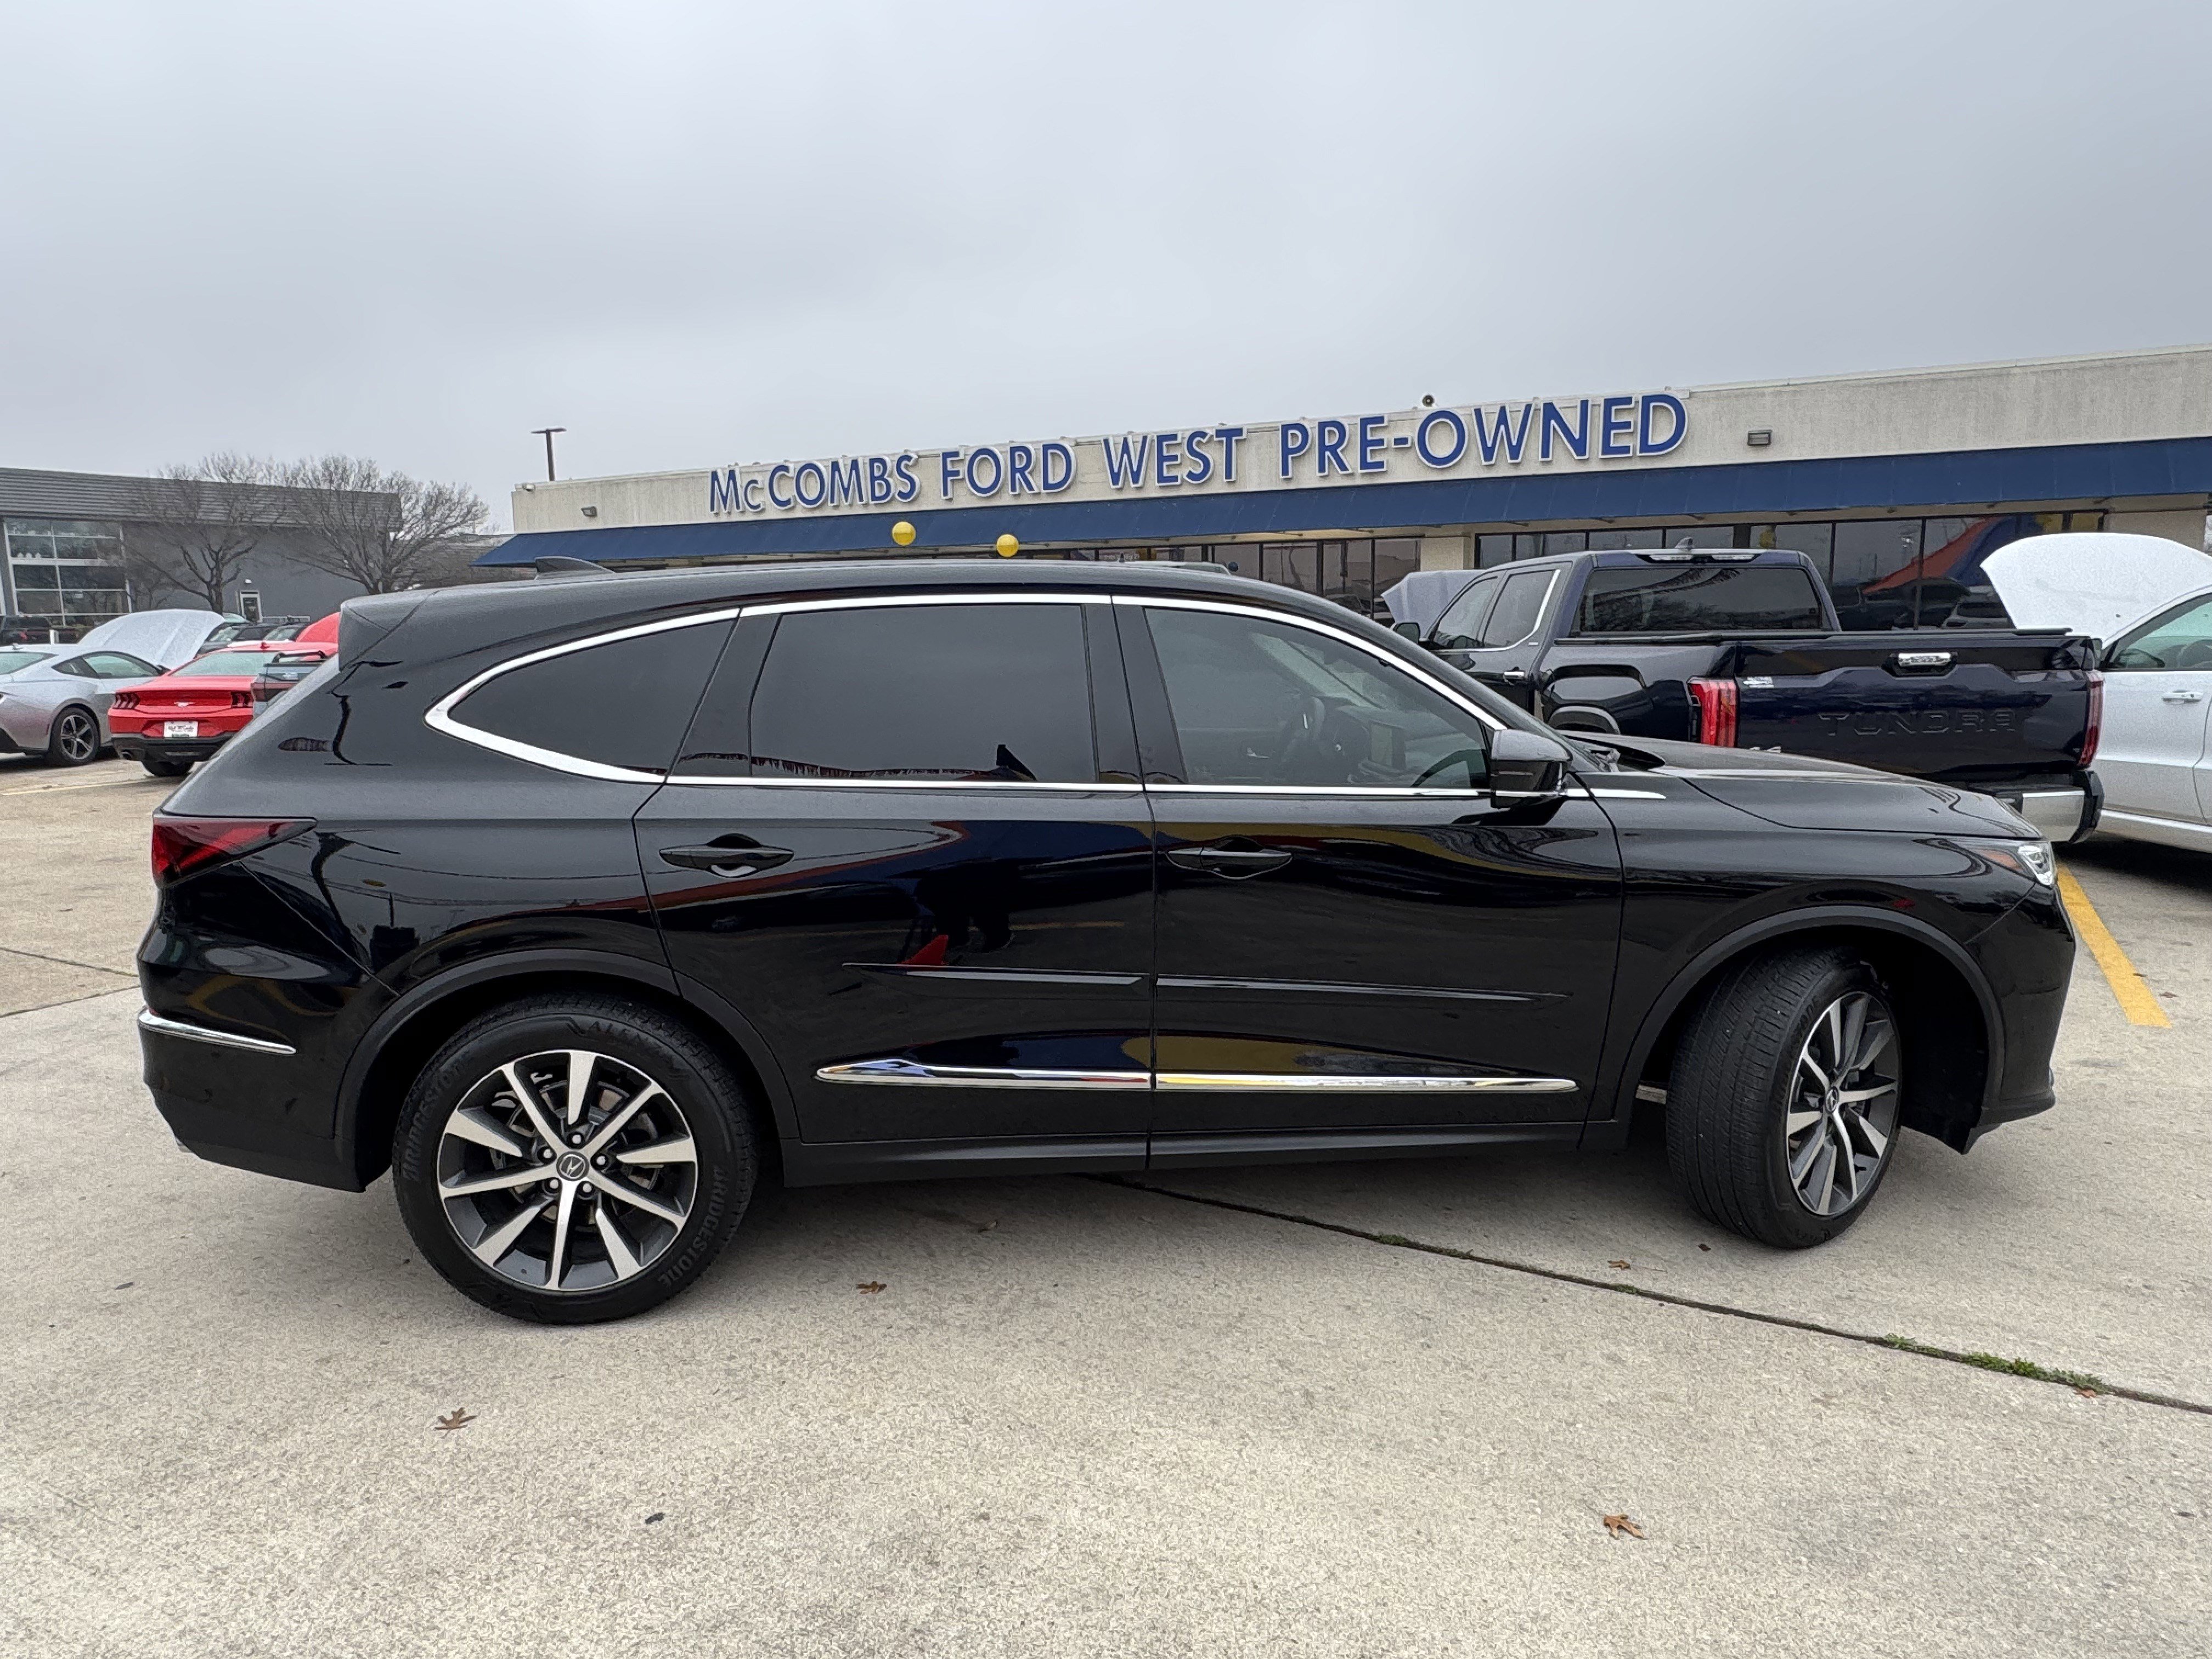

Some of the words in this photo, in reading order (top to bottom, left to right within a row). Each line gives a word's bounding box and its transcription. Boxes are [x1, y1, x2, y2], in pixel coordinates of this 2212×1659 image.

[709, 450, 920, 513] McCOMBS
[940, 442, 1076, 500] FORD
[1102, 427, 1246, 488] WEST
[1279, 393, 1688, 479] PRE-OWNED
[1818, 710, 2016, 736] TUNDRA
